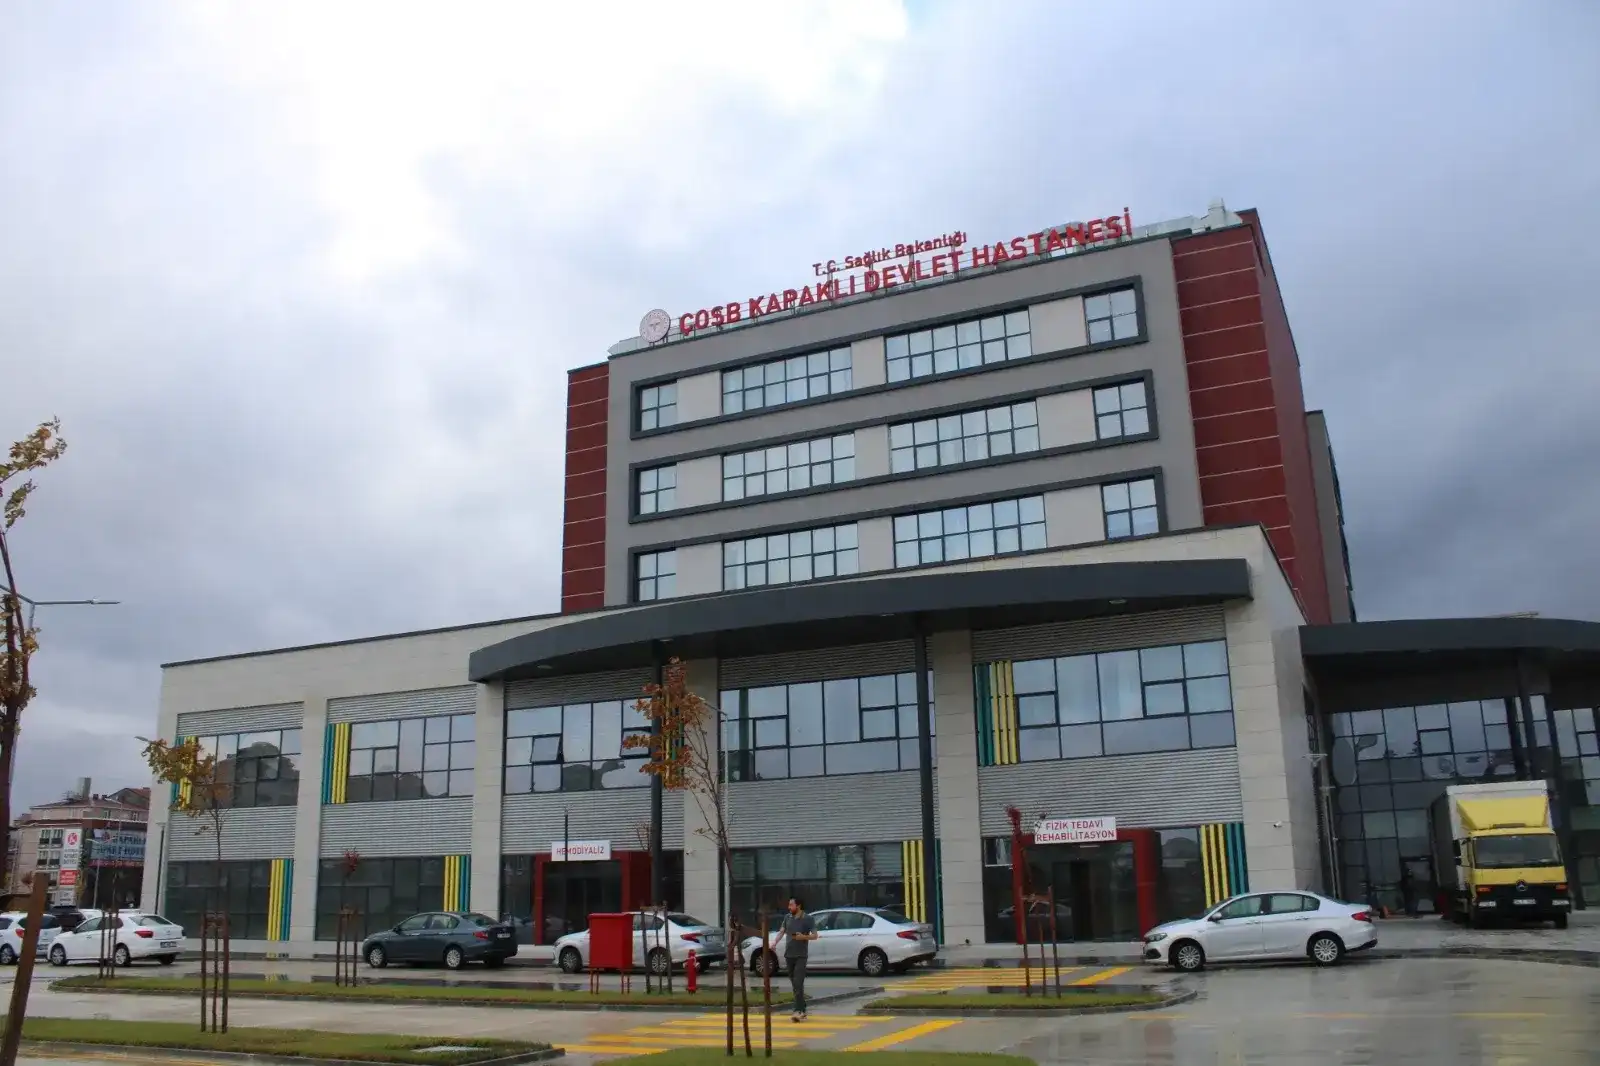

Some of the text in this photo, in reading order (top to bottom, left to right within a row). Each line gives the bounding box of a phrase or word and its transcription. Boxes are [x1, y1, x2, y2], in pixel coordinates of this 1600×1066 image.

[749, 274, 855, 319] KAPAKLI
[864, 250, 963, 293] DEVLET
[972, 206, 1132, 269] HASTANESİ
[812, 230, 967, 276] T.C. Sağlık Bakanlığı
[1036, 829, 1115, 842] REHABİLİTASYON
[1045, 819, 1104, 829] FİZİK TEDAVİ
